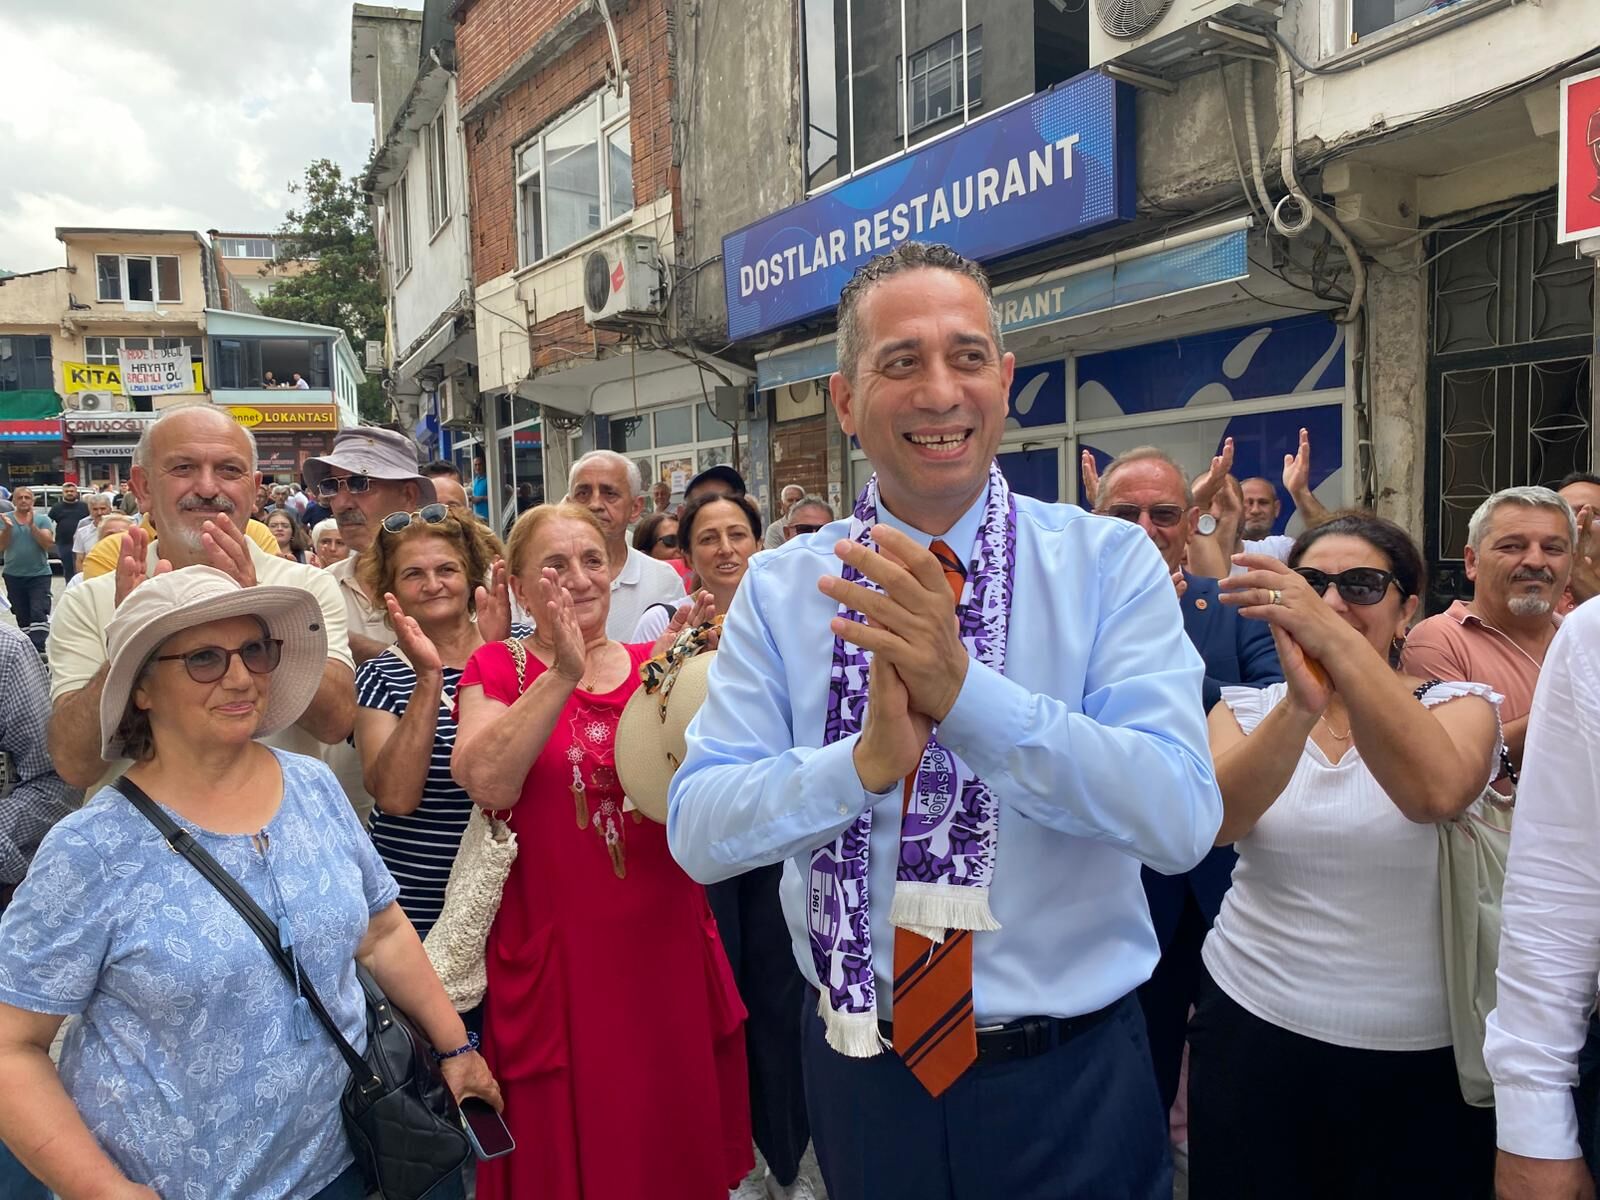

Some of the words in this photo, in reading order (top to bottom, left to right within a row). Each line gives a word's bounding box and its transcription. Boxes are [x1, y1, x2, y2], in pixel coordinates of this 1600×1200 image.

[739, 228, 848, 298] DOSTLAR
[853, 132, 1081, 257] RESTAURANT
[131, 362, 175, 372] HAYATA
[71, 366, 121, 384] KİTA
[166, 372, 182, 382] OL
[232, 414, 259, 422] ennet
[264, 412, 332, 422] LOKANTASI
[920, 742, 949, 825] HOPASPOR
